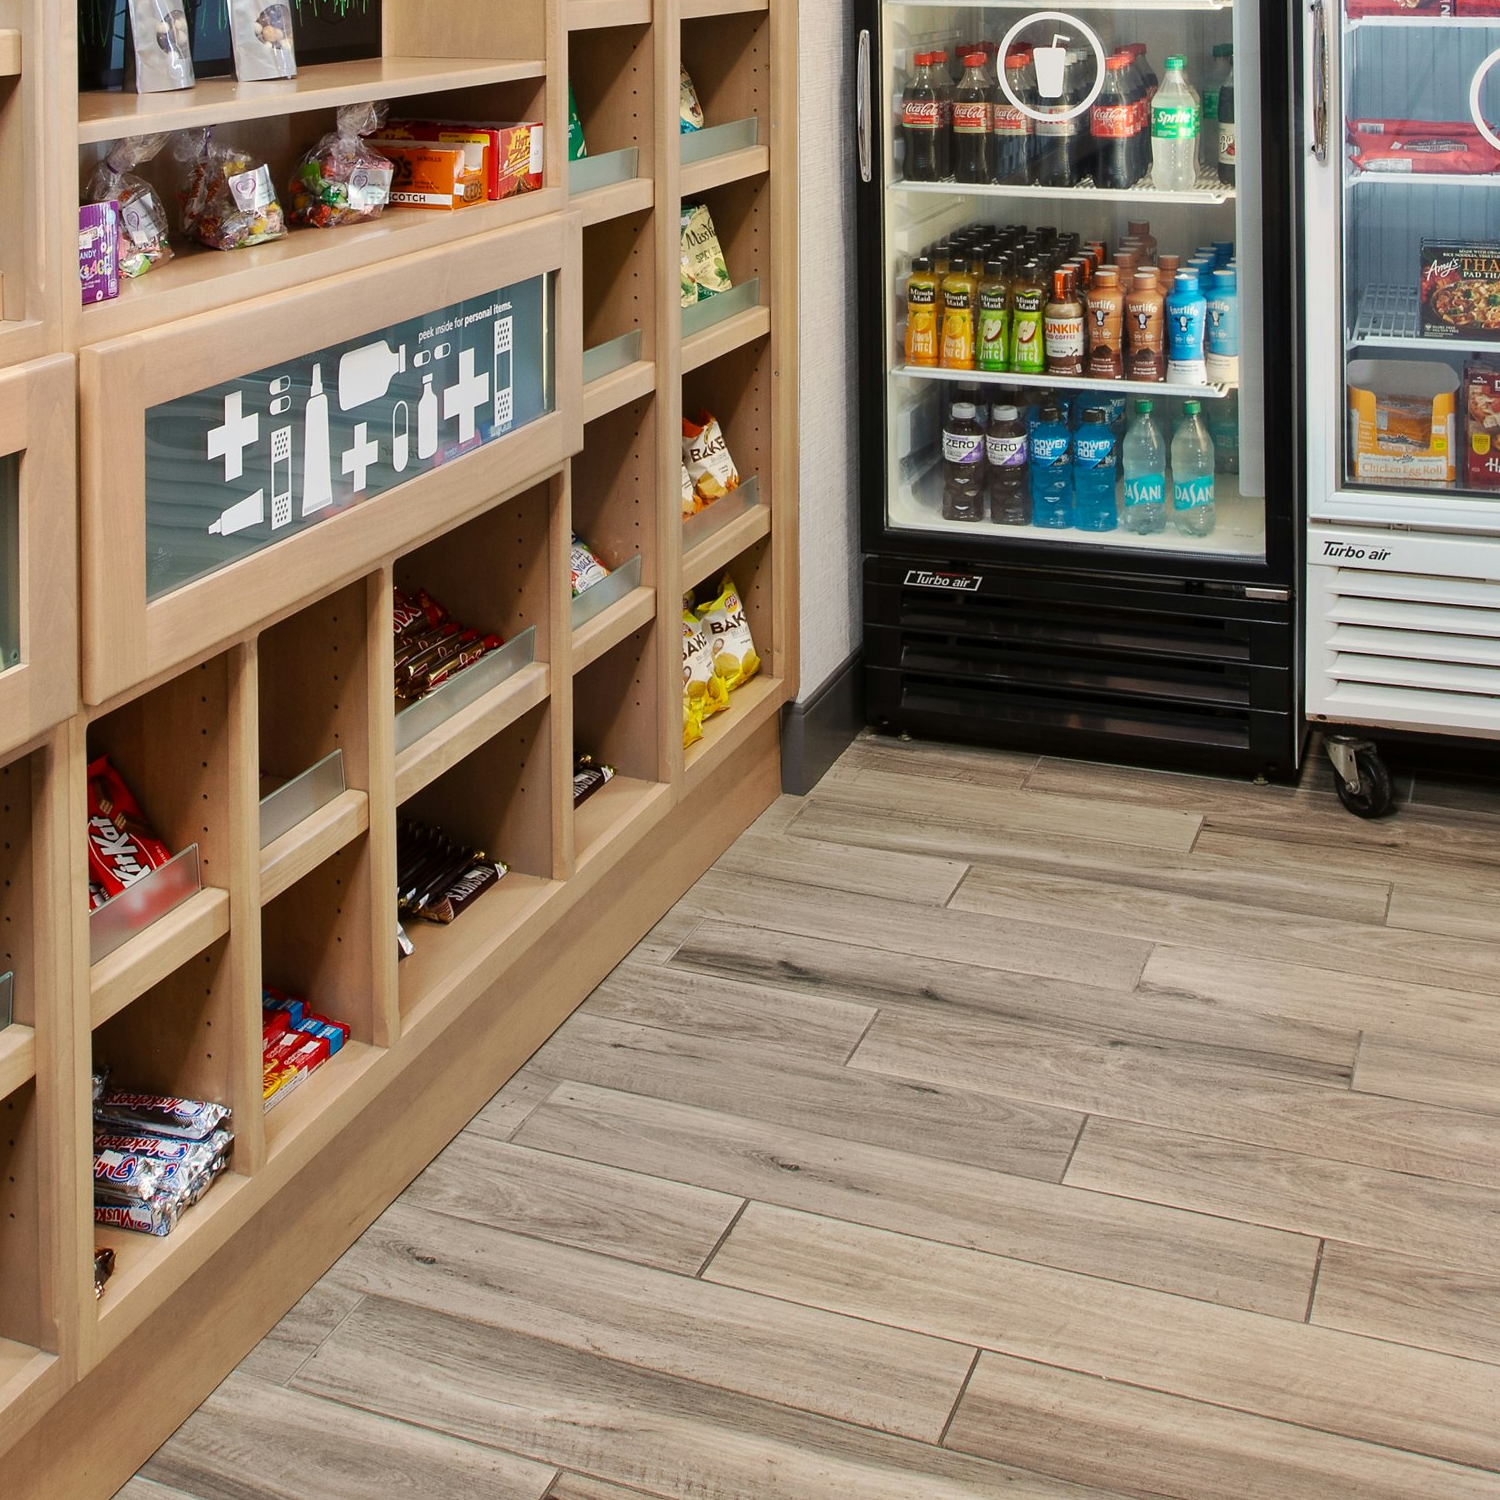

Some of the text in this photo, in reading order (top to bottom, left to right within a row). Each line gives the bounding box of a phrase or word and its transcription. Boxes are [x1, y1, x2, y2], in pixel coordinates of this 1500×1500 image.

[1441, 4, 1450, 15] 2
[1157, 108, 1191, 126] Sprite
[1425, 258, 1461, 280] Amy's
[910, 287, 933, 297] Minute
[944, 292, 967, 301] Minute
[913, 295, 931, 303] Maid
[946, 299, 964, 307] Maid
[980, 295, 1004, 303] Minute
[1015, 295, 1039, 304] Minute
[983, 301, 1001, 309] Maid
[1018, 302, 1036, 310] Maid
[1129, 303, 1157, 313] fairlife
[1170, 306, 1198, 316] fairlife
[418, 301, 513, 344] peek inside for personal items.
[946, 439, 975, 449] ZERO
[988, 441, 1017, 452] ZERO
[1033, 438, 1067, 449] POWER
[1077, 440, 1111, 450] POWER
[1362, 463, 1442, 477] Chicken Egg Roll
[1324, 540, 1392, 562] Turbo air
[915, 571, 971, 588] Turbo air
